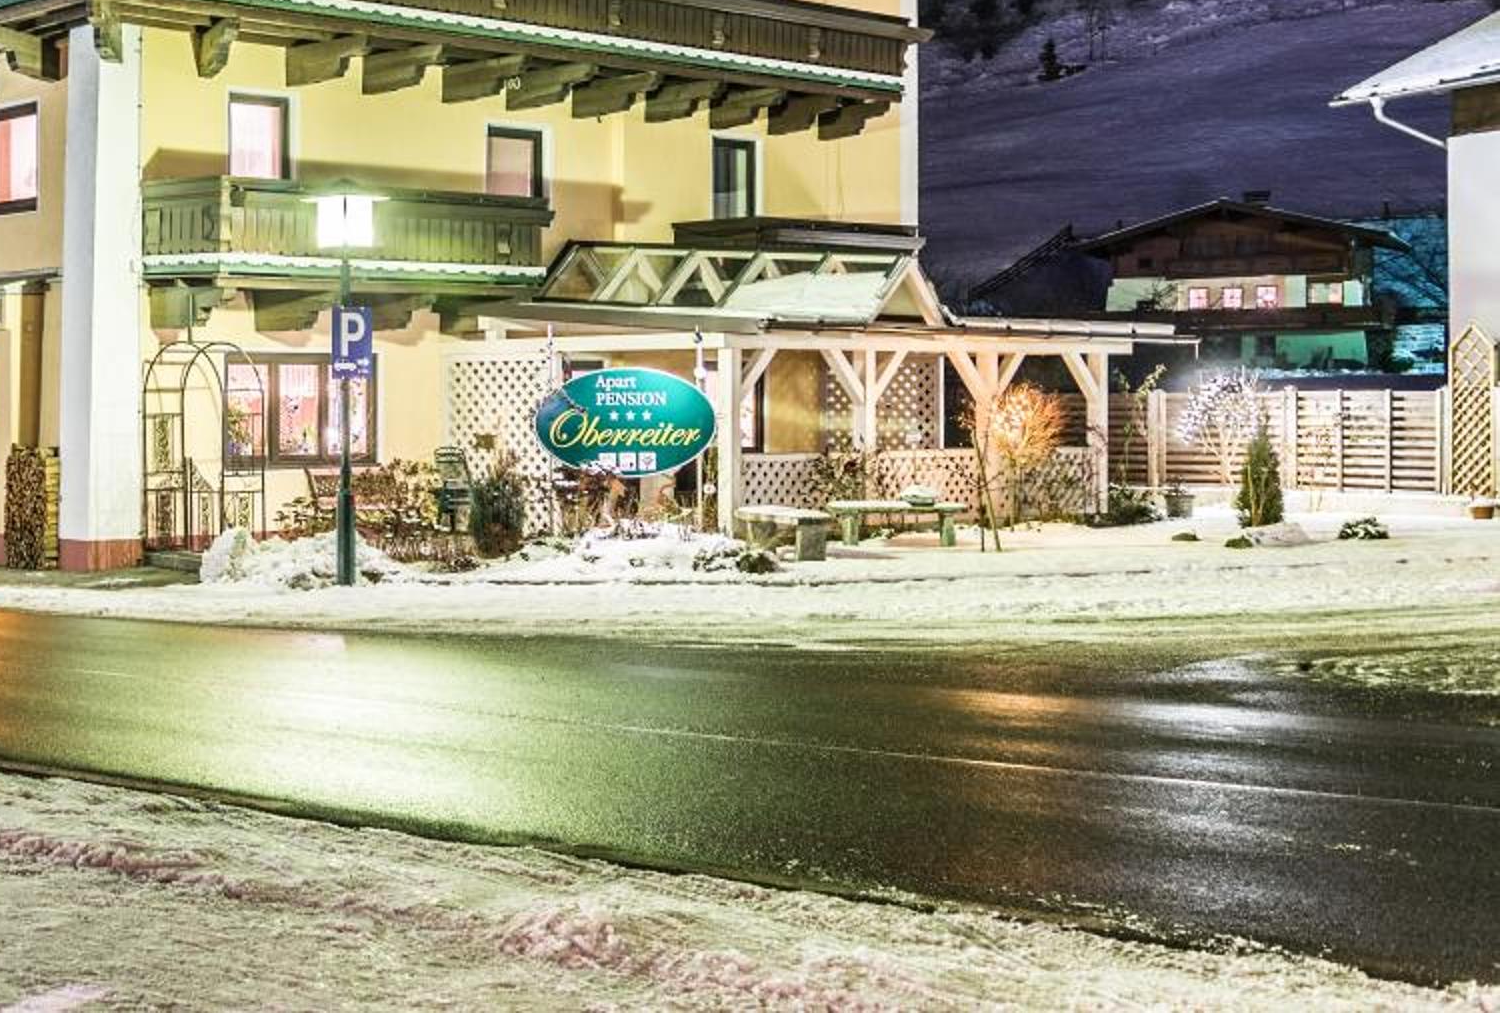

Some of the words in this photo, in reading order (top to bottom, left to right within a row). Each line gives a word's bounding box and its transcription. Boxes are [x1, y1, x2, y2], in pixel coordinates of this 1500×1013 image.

[340, 312, 365, 357] P
[596, 375, 636, 391] Apart
[596, 391, 667, 406] PENSION
[550, 408, 701, 448] Oberreiter
